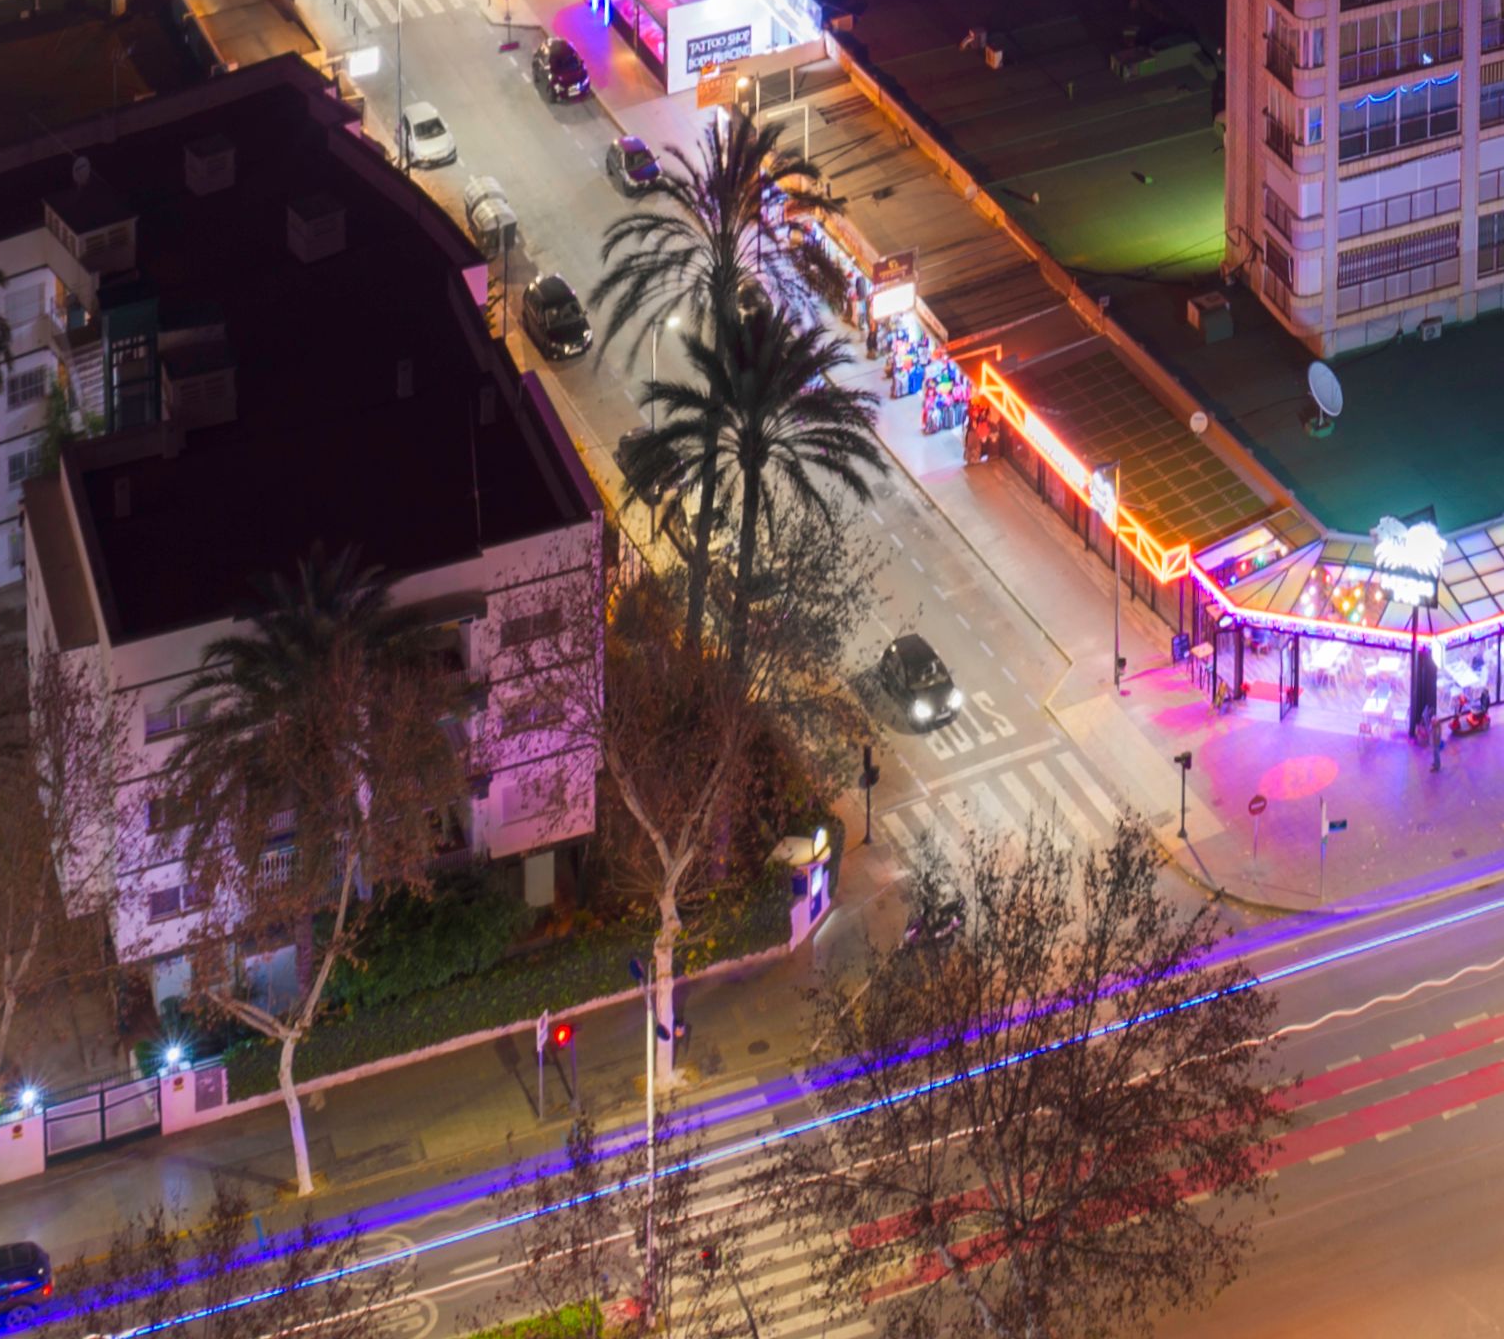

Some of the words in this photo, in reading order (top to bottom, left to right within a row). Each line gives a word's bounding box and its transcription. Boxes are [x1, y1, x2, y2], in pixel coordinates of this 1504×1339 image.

[688, 36, 727, 56] TATTOO
[727, 29, 751, 47] SHOP
[687, 53, 713, 72] BODY
[713, 44, 752, 66] PIERCING
[925, 690, 1019, 761] STOP
